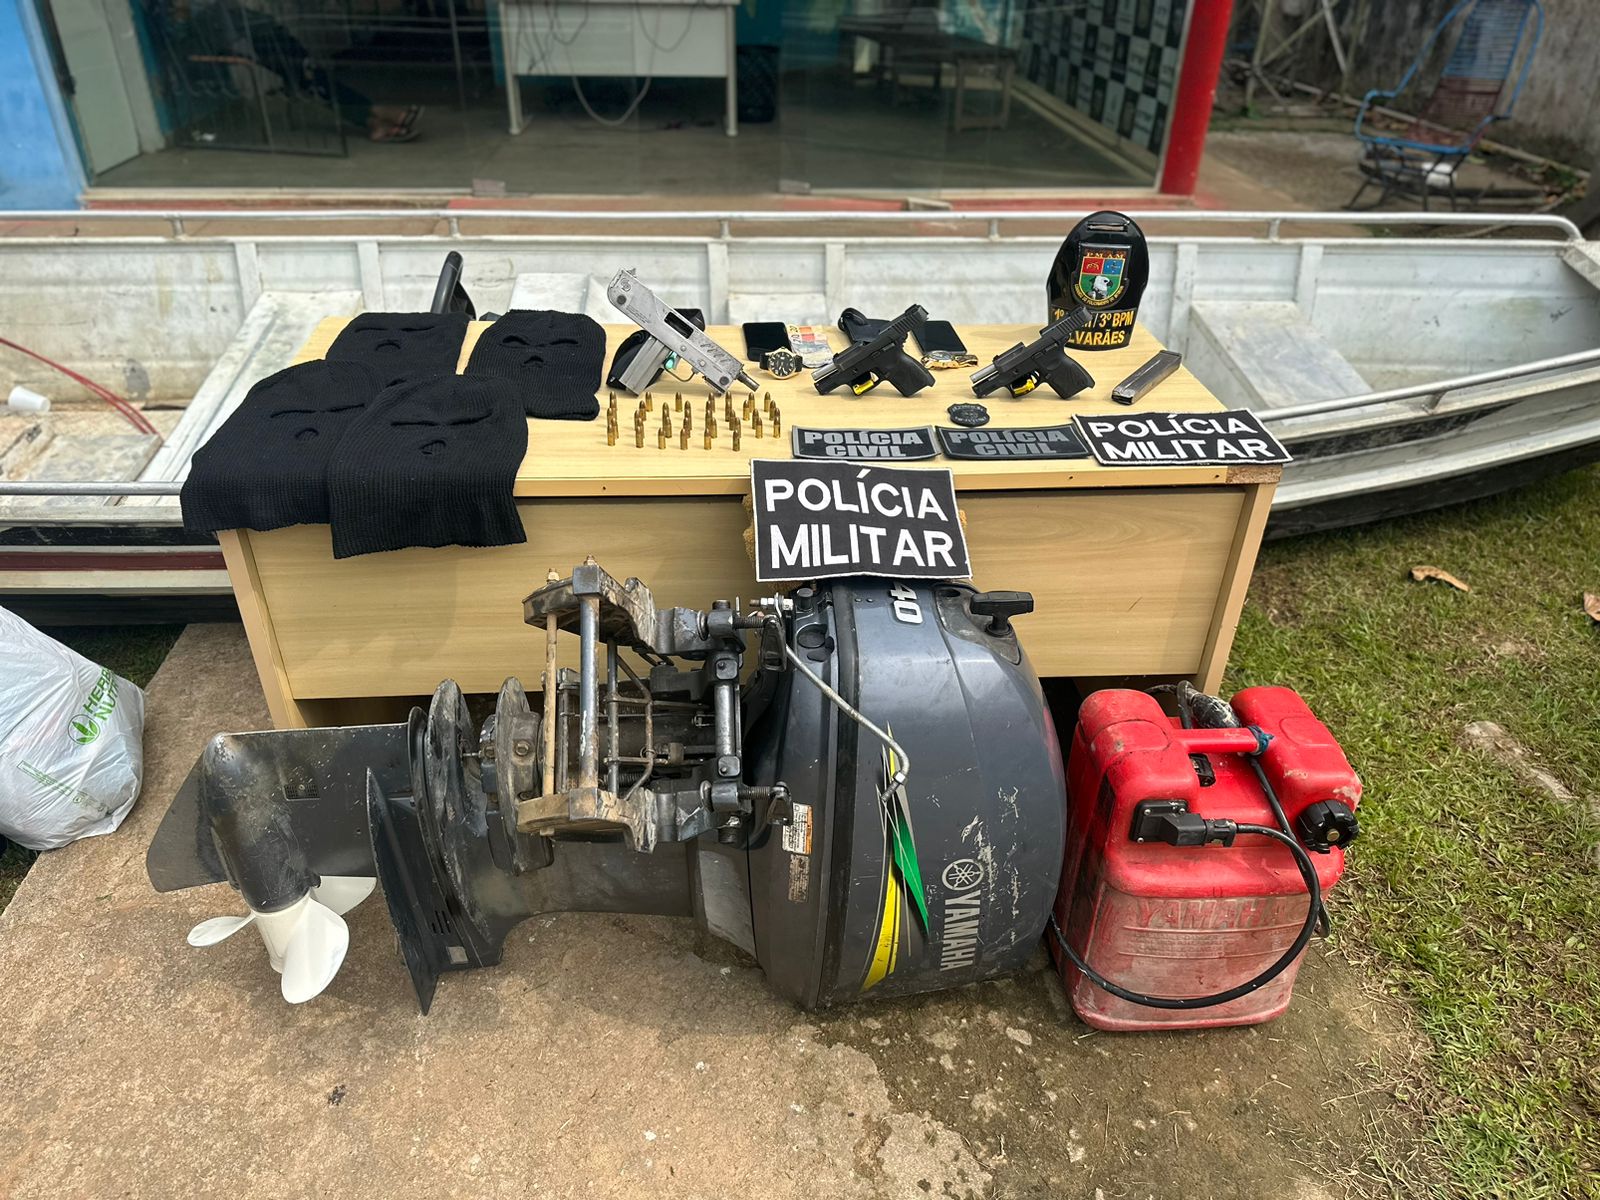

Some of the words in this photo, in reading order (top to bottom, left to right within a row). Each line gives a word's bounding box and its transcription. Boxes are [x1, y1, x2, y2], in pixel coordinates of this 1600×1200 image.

[1112, 310, 1135, 327] BPM
[1068, 328, 1126, 346] LVARÃES
[1087, 414, 1258, 438] POLÍCIA
[804, 431, 924, 445] POLÍCIA
[948, 429, 1070, 444] POLÍCIA
[825, 445, 907, 457] CIVIL
[974, 442, 1057, 455] CIVIL
[1102, 438, 1276, 460] MILITAR
[764, 468, 949, 522] POLÍCIA
[769, 523, 957, 569] MILITAR
[890, 580, 923, 624] 40
[940, 889, 981, 972] YAMAHA
